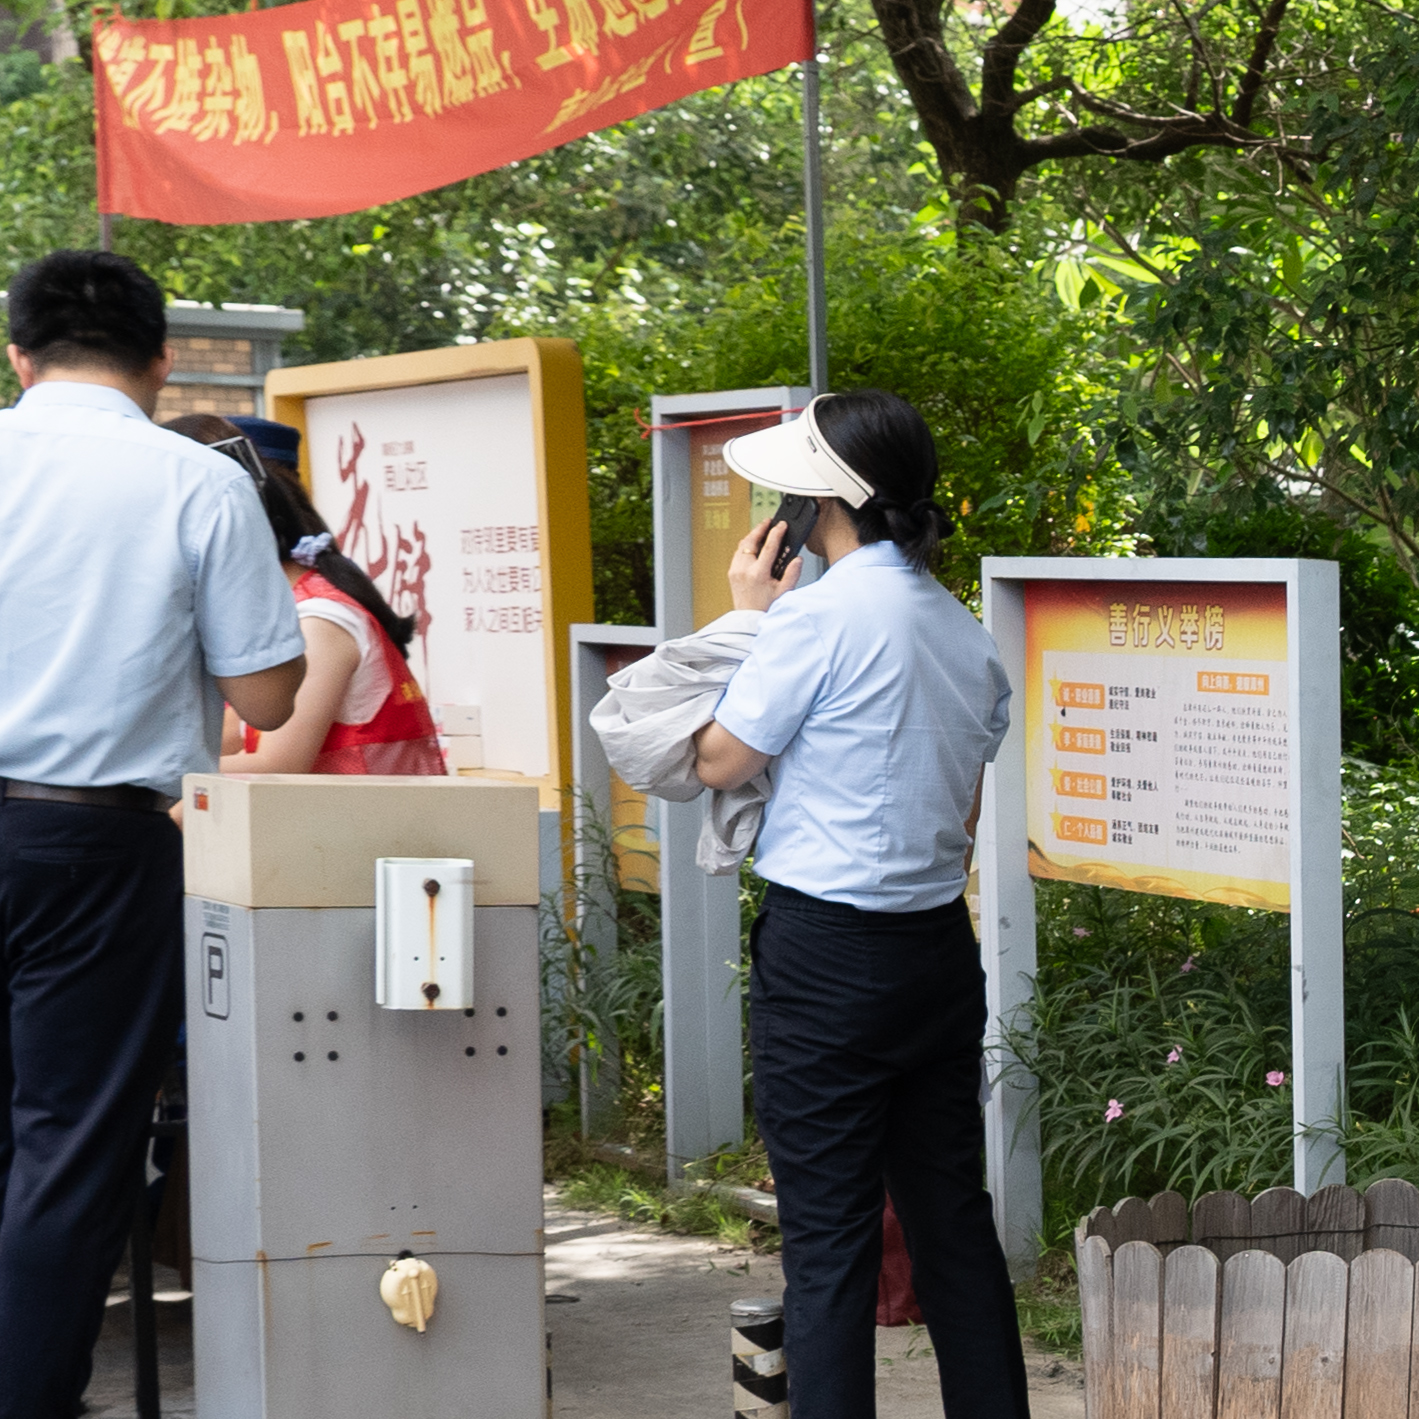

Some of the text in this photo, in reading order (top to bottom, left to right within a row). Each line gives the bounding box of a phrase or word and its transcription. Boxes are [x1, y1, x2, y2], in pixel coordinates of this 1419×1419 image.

[1108, 602, 1225, 651] 善行义举榜
